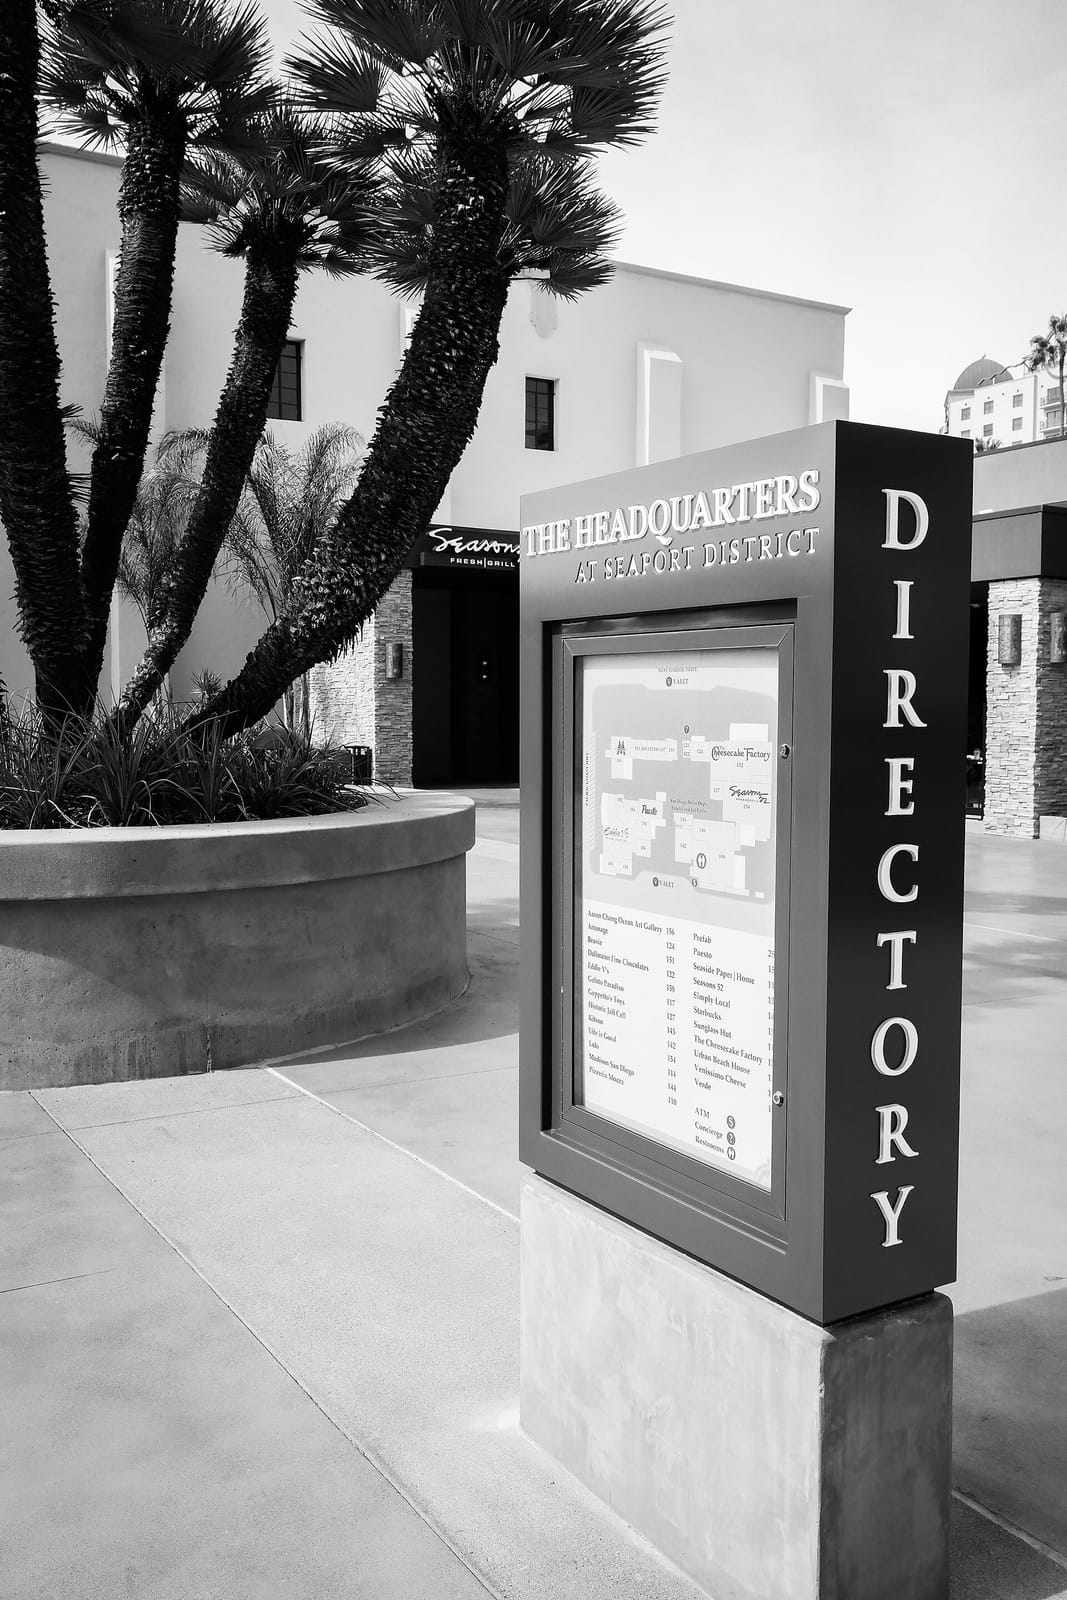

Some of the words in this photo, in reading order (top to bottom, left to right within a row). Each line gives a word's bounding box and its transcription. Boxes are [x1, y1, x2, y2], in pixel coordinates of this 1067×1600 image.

[522, 518, 572, 557] THE
[573, 469, 822, 546] HEADQUARTERS
[574, 560, 597, 584] AT
[603, 545, 695, 580] SEAPORT
[702, 526, 820, 568] DISTRICT
[743, 747, 771, 762] Factory
[870, 488, 929, 1247] DIRECTORY
[602, 912, 618, 924] Chang
[618, 916, 634, 926] Ocean
[643, 922, 662, 935] Gallery
[693, 933, 712, 943] Prefab
[693, 947, 713, 959] Puesto
[693, 962, 715, 974] Seaside
[715, 967, 733, 980] Paper
[736, 972, 755, 985] Home
[693, 976, 716, 990] Seasons
[716, 983, 724, 992] 52
[693, 991, 714, 1005] Simply
[715, 996, 730, 1008] Local
[693, 1005, 722, 1021] Starbucks
[693, 1020, 719, 1035] Sunglass
[719, 1028, 732, 1039] Hut
[694, 1034, 705, 1045] The
[705, 1038, 740, 1056] Cheesecake
[740, 1049, 762, 1066] Factory
[694, 1048, 712, 1062] Urban
[712, 1055, 730, 1068] Beach
[731, 1061, 751, 1075] House
[694, 1063, 725, 1081] Venissimo
[725, 1074, 747, 1089] Cheese
[694, 1077, 711, 1091] Verde
[694, 1106, 710, 1119] ATM
[694, 1120, 723, 1140] Concierge
[695, 1135, 725, 1154] Restrooms
